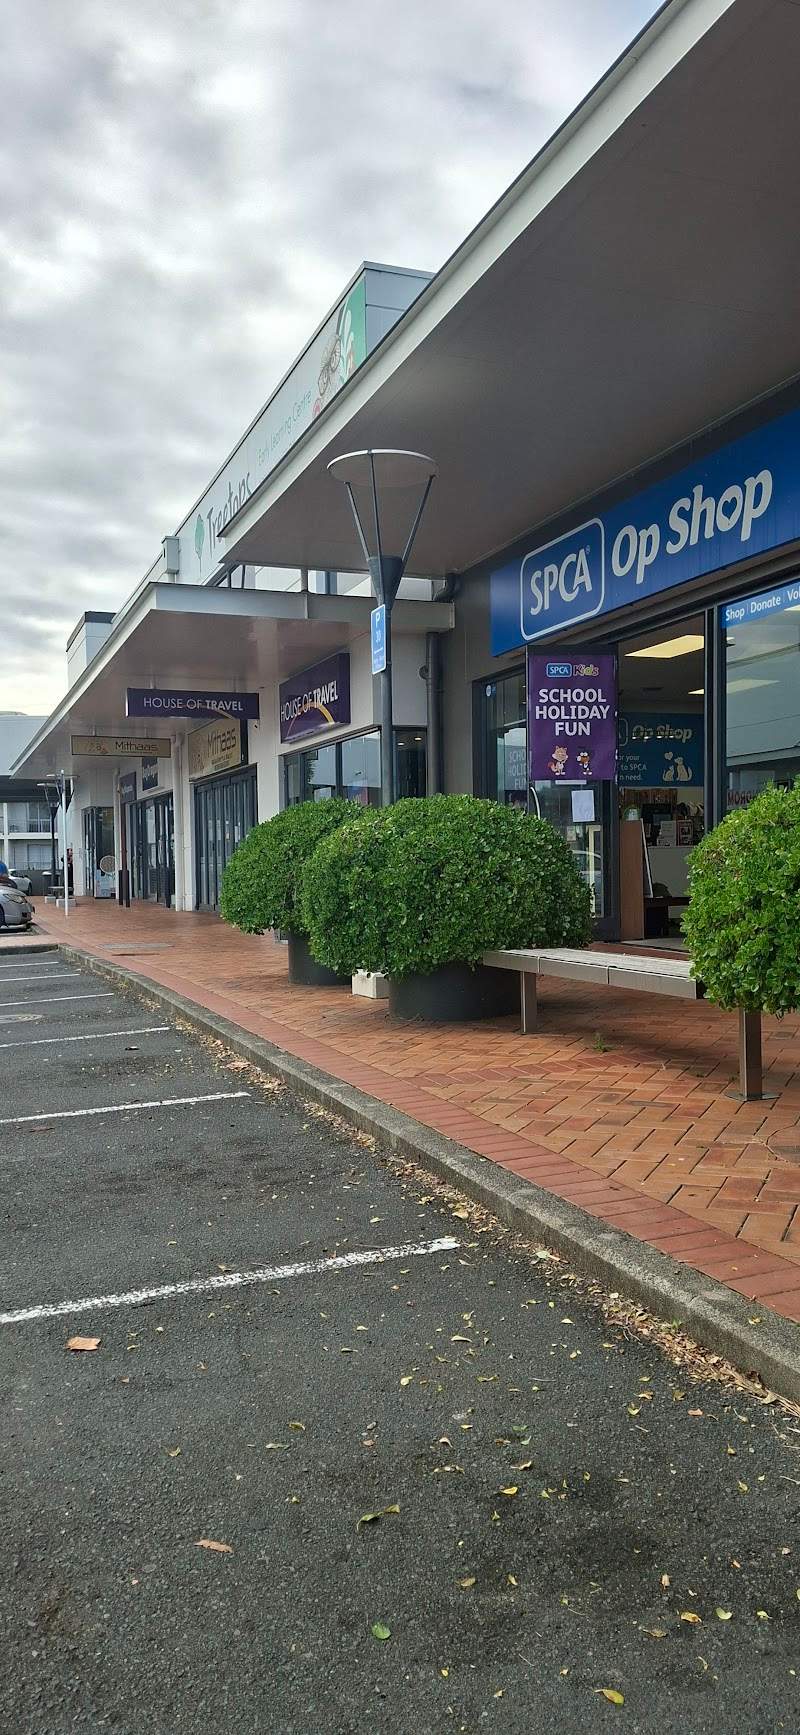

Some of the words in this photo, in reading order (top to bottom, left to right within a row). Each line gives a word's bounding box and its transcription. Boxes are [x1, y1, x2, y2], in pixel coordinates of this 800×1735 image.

[611, 524, 660, 584] Op
[666, 469, 772, 554] Shop
[530, 548, 592, 615] SPCA
[726, 609, 745, 621] Shop
[750, 596, 781, 613] Donate
[550, 666, 569, 674] SPCA
[573, 664, 599, 676] Kids
[143, 697, 183, 709] HOUSE
[186, 699, 202, 710] OF
[205, 700, 243, 711] TRAVEL
[281, 697, 301, 722] HOUSE
[303, 692, 313, 713] OF
[313, 680, 338, 708] TRAVEL
[538, 689, 606, 703] SCHOOL
[535, 705, 610, 719] HOLIDAY
[555, 722, 590, 736] FUN
[632, 725, 654, 742] Op
[657, 724, 693, 743] Shop
[115, 741, 159, 752] Mithaas
[207, 728, 236, 758] Mithaas
